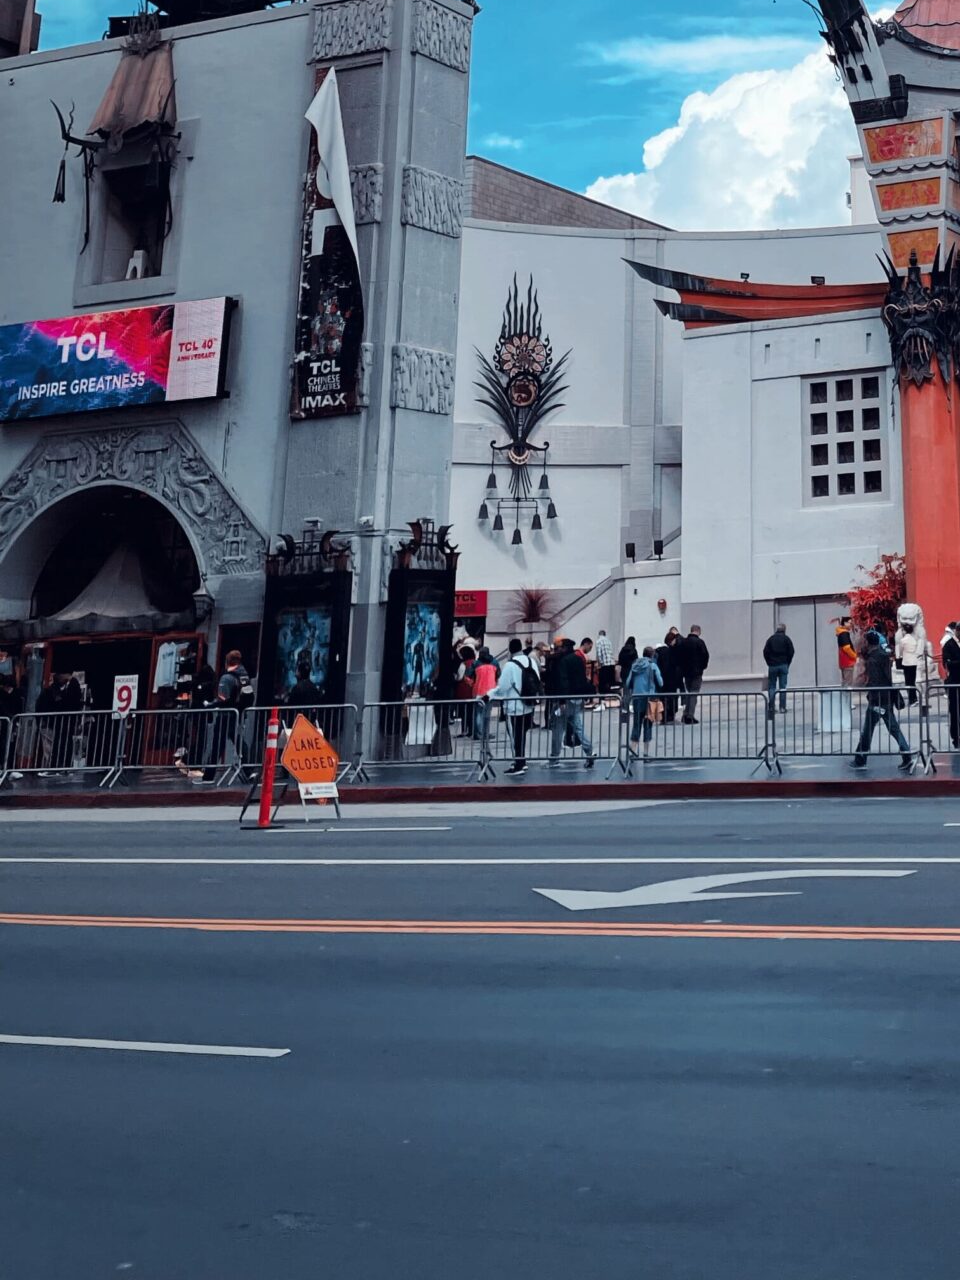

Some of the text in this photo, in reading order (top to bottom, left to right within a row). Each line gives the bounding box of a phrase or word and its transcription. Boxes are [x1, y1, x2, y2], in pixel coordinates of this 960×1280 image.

[57, 331, 114, 363] TCL
[178, 340, 198, 352] TCL
[310, 360, 340, 375] TCL
[17, 371, 146, 401] INSPIRE GREATNESS
[307, 373, 341, 386] CHINESE
[301, 392, 346, 409] IMAX
[293, 737, 322, 751] LANE
[290, 756, 335, 771] CLOSED
